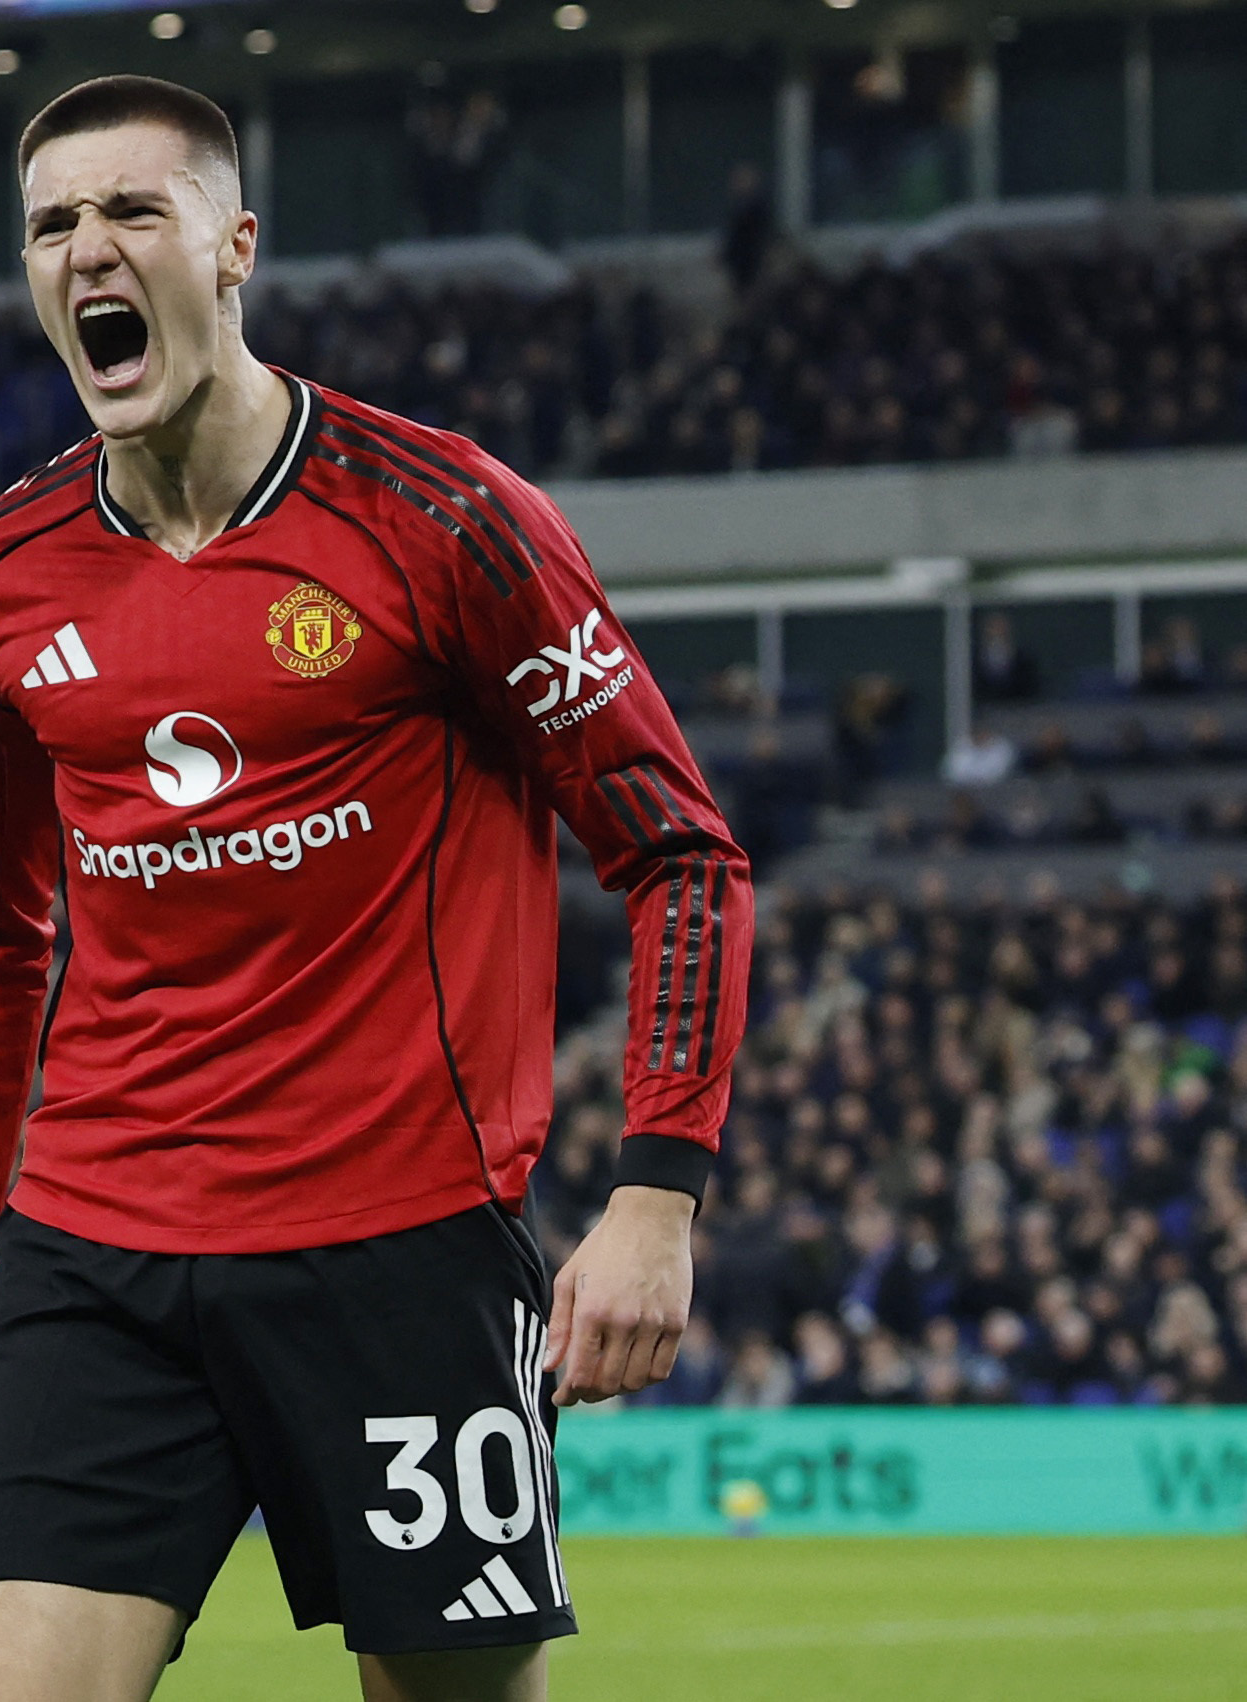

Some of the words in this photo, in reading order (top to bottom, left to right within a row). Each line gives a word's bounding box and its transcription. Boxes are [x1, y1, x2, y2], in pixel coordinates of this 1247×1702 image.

[275, 588, 352, 621] MANCHESTER
[287, 653, 342, 672] UNITED
[505, 607, 626, 718] DXC
[538, 665, 635, 735] TECHNOLOGY
[72, 800, 373, 889] Snapdragon
[364, 1406, 536, 1550] 30
[701, 1428, 919, 1519] Eats
